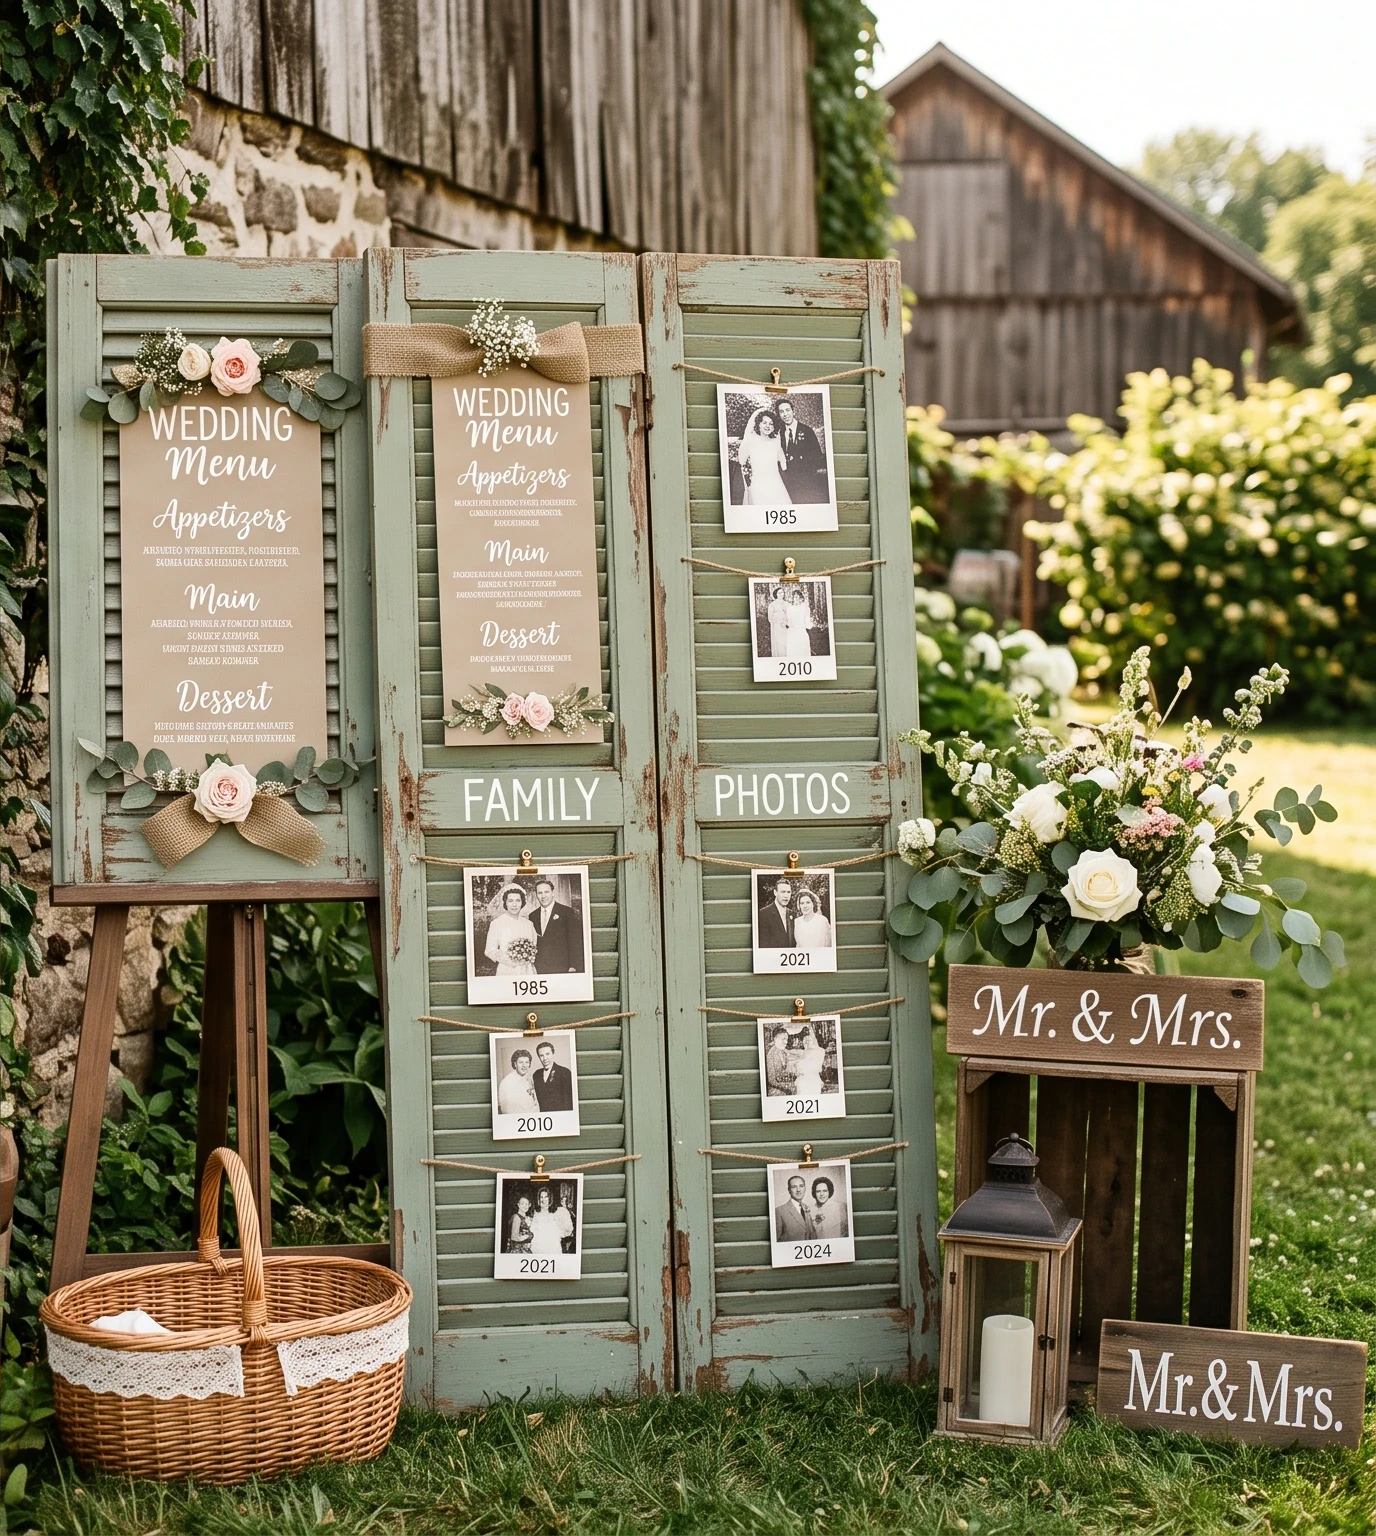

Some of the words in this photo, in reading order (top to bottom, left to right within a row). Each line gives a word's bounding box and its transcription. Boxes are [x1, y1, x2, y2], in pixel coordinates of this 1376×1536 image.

[453, 388, 569, 416] WEDDING
[148, 406, 293, 441] WEDDING
[466, 419, 558, 452] Menu
[165, 445, 276, 485] Menu
[458, 460, 571, 495] Appetizers
[153, 499, 291, 540] Appetizers
[766, 510, 797, 525] 1985
[484, 540, 549, 566] Main
[184, 583, 260, 614] Main
[480, 621, 560, 648] Dessert
[779, 661, 812, 676] 2010
[177, 680, 273, 715] Dessert
[464, 777, 600, 822] FAMILY
[714, 772, 851, 816] PHOTOS
[780, 952, 810, 967] 2021
[512, 980, 548, 996] 1985
[971, 984, 1057, 1039] Mr.
[1071, 989, 1115, 1044] &
[1129, 993, 1242, 1050] Mrs.
[785, 1100, 820, 1115] 2021
[517, 1117, 553, 1133] 2010
[520, 1259, 556, 1274] 2021
[794, 1244, 832, 1260] 2024
[1243, 1360, 1342, 1432] Mrs.
